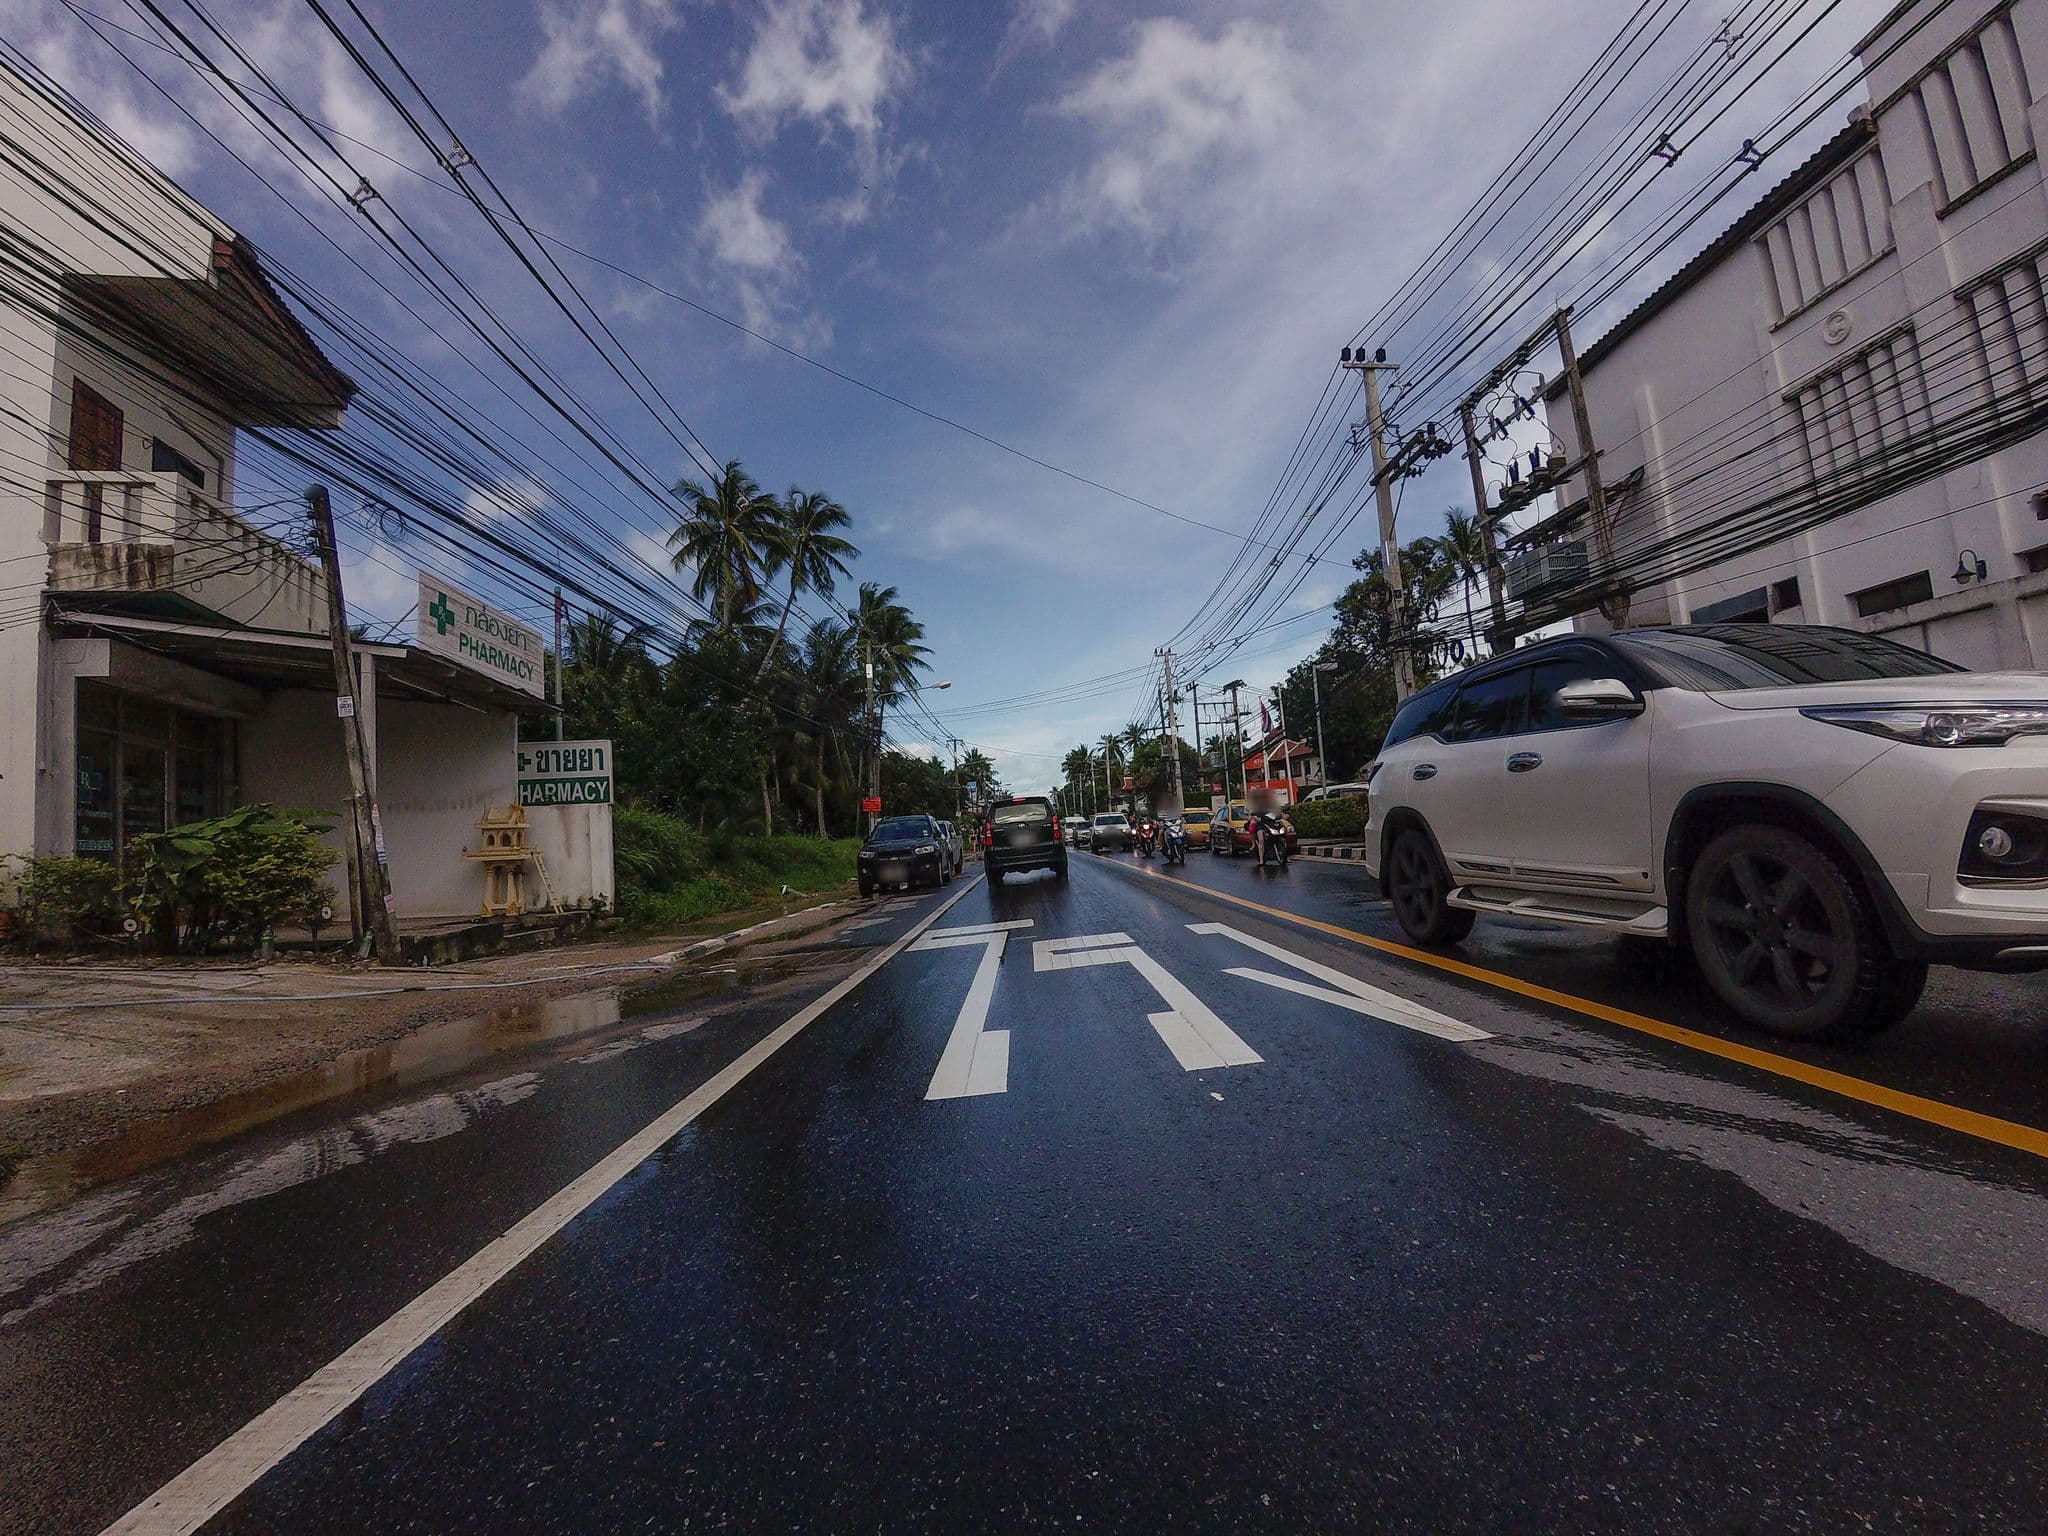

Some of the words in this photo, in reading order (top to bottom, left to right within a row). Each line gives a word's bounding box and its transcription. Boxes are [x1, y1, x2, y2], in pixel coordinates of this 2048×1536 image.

[464, 604, 528, 652] กล่องยา
[459, 631, 534, 681] PHARMACY
[535, 747, 604, 773] ขายยา
[519, 781, 608, 804] HARMACY
